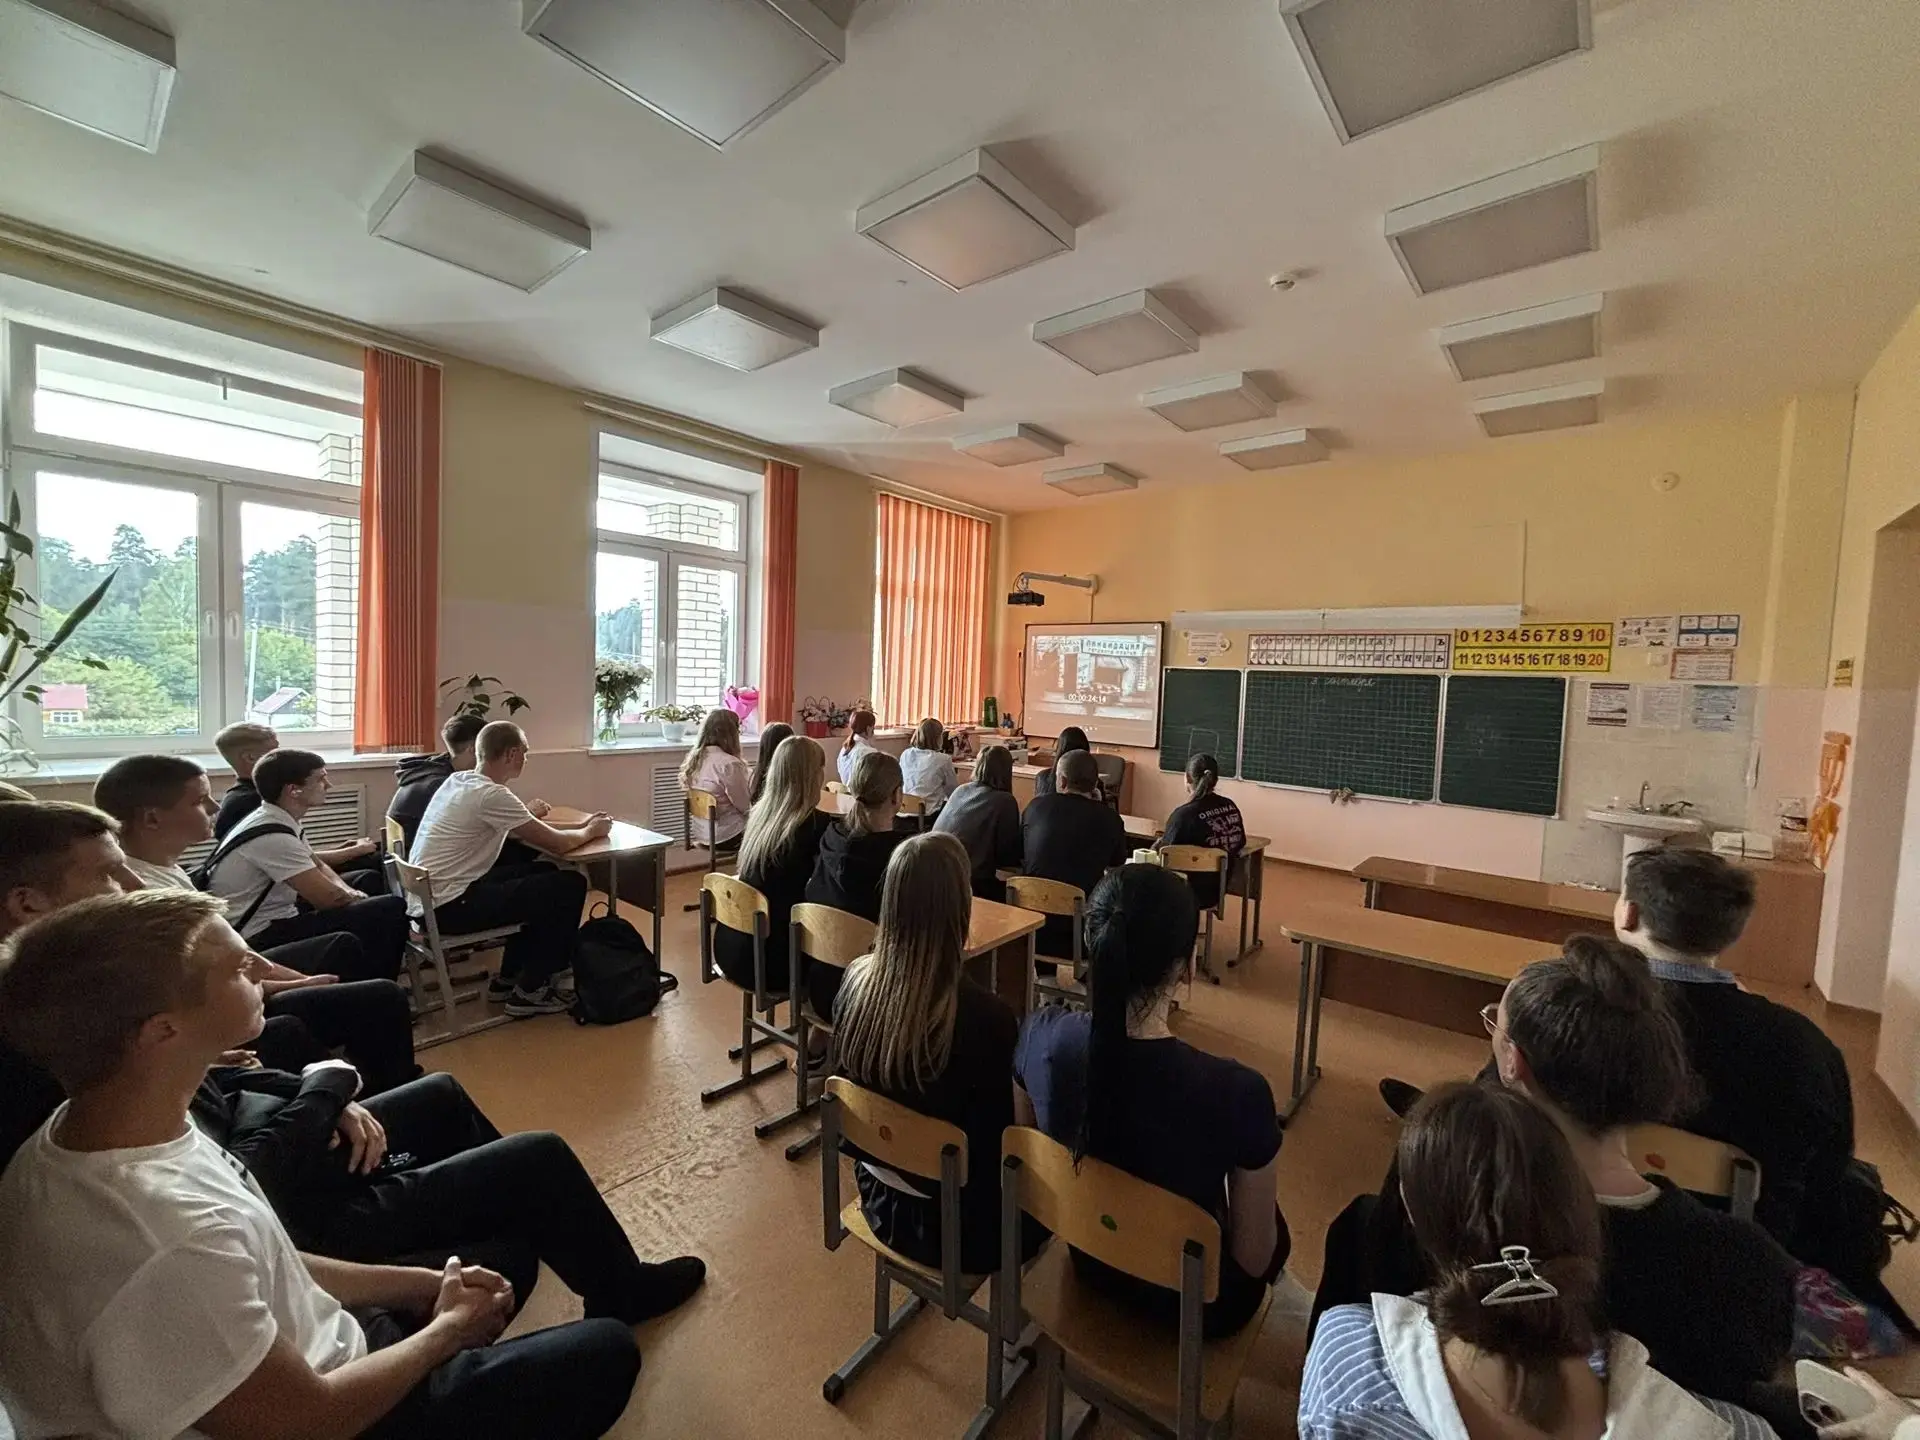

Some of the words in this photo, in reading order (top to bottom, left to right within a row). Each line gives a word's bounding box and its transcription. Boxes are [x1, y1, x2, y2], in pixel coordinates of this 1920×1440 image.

[1460, 630, 1469, 642] 0
[1472, 630, 1479, 642] 1
[1483, 630, 1493, 642] 2
[1495, 630, 1505, 642] 3
[1507, 629, 1517, 642] 4
[1520, 629, 1530, 642] 5
[1533, 629, 1543, 641] 6
[1546, 629, 1556, 641] 7
[1559, 629, 1569, 641] 8
[1572, 629, 1582, 641] 9
[1588, 629, 1605, 641] 10
[1458, 654, 1468, 665] 11
[1471, 654, 1482, 665] 12
[1485, 654, 1496, 665] 13
[1499, 654, 1510, 665] 14
[1513, 654, 1525, 665] 15
[1528, 654, 1539, 665] 16
[1542, 654, 1555, 665] 17
[1557, 654, 1569, 665] 18
[1572, 654, 1586, 665] 19
[1587, 654, 1604, 665] 20
